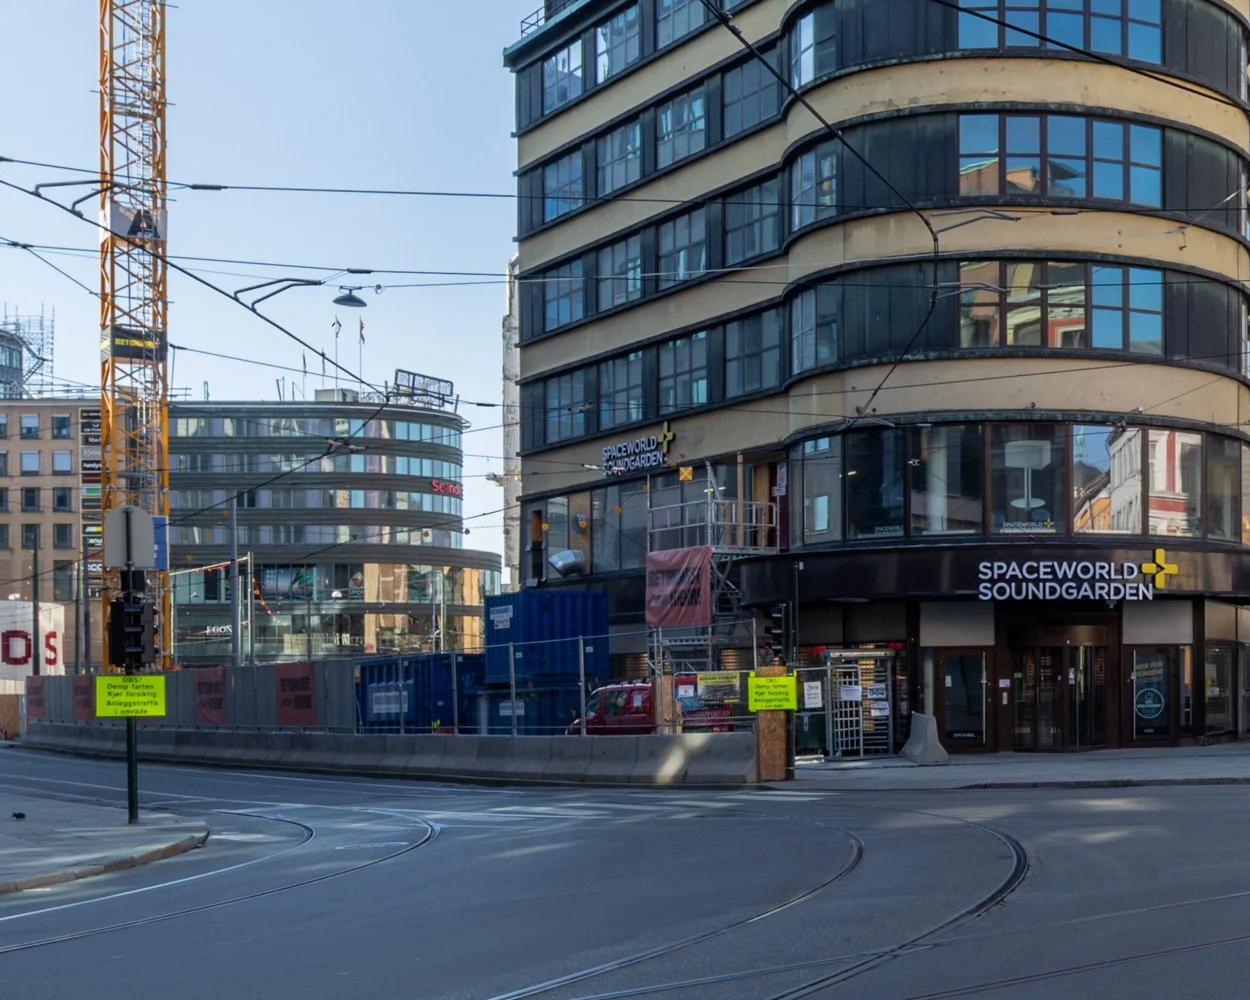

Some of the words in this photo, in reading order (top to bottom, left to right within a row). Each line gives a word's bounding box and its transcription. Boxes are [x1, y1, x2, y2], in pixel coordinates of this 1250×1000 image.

[127, 209, 161, 239] A
[602, 435, 657, 460] SPACEWORLD
[602, 451, 664, 476] SOUNDGARDEN
[978, 561, 1138, 580] SPACEWORLD
[978, 582, 1153, 601] SOUNDGARDEN
